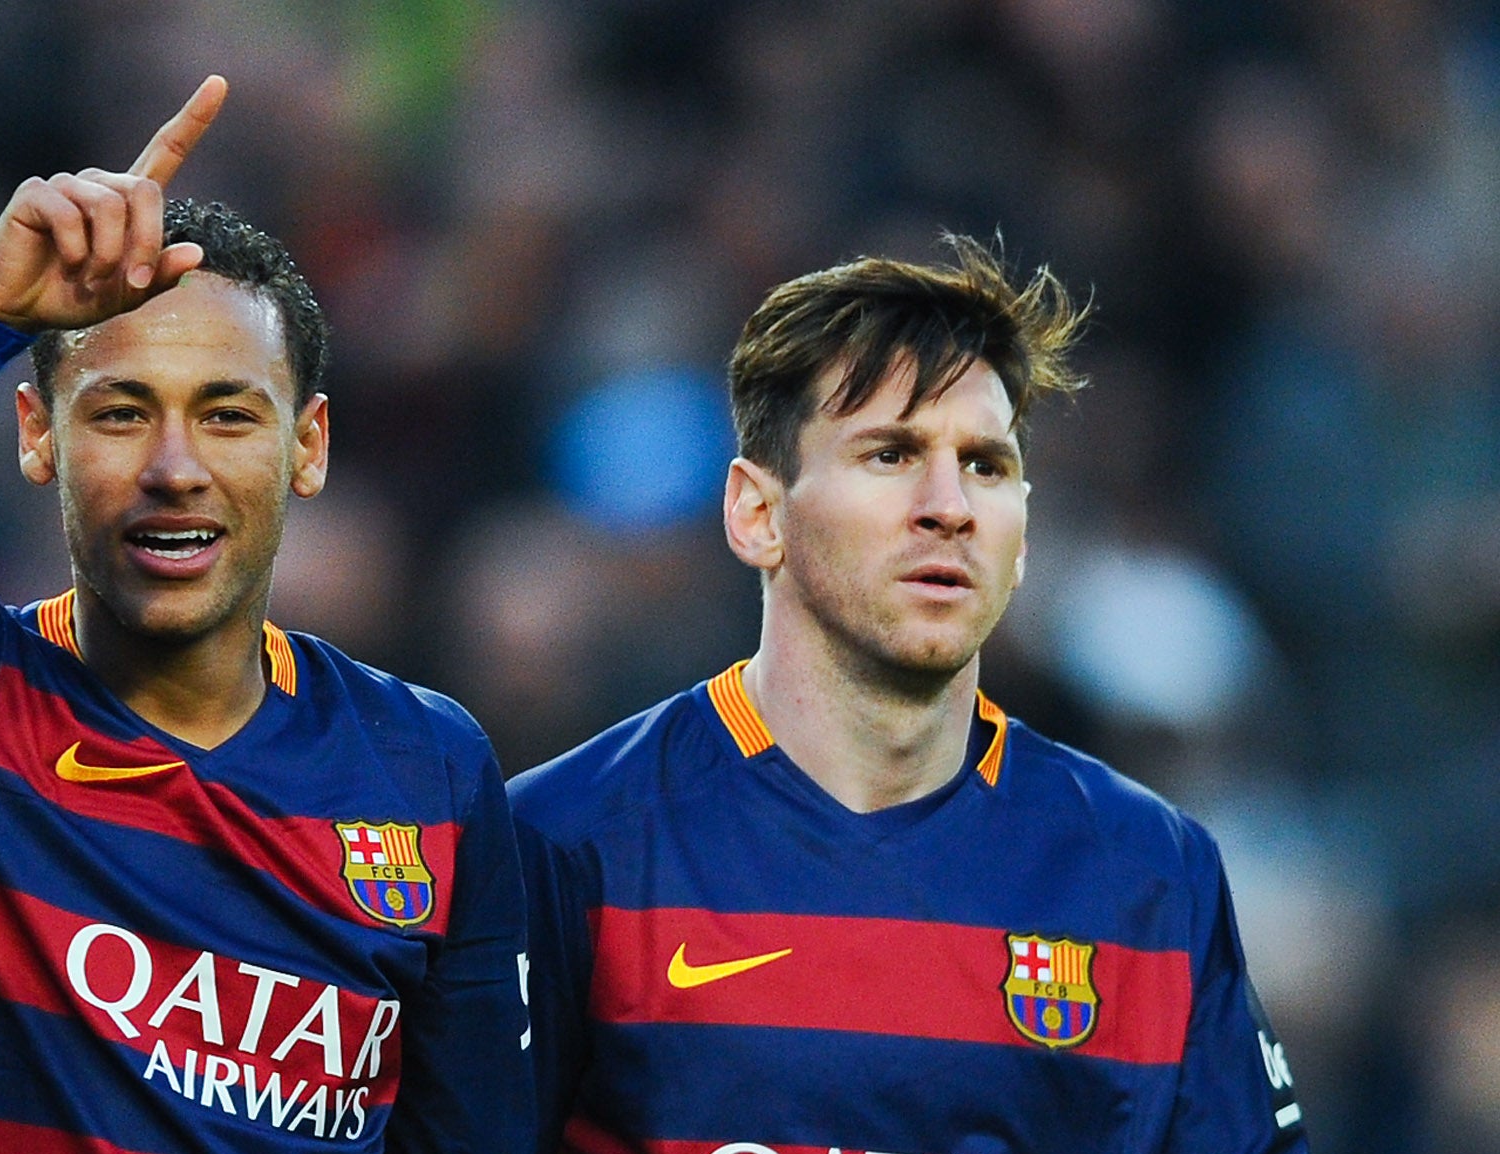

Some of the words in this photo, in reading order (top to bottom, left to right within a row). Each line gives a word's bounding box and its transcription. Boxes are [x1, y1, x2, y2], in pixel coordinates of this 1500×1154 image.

[371, 865, 406, 880] FCB
[65, 922, 401, 1081] QATAR
[1033, 981, 1069, 1000] FCB
[143, 1039, 370, 1141] AIRWAYS
